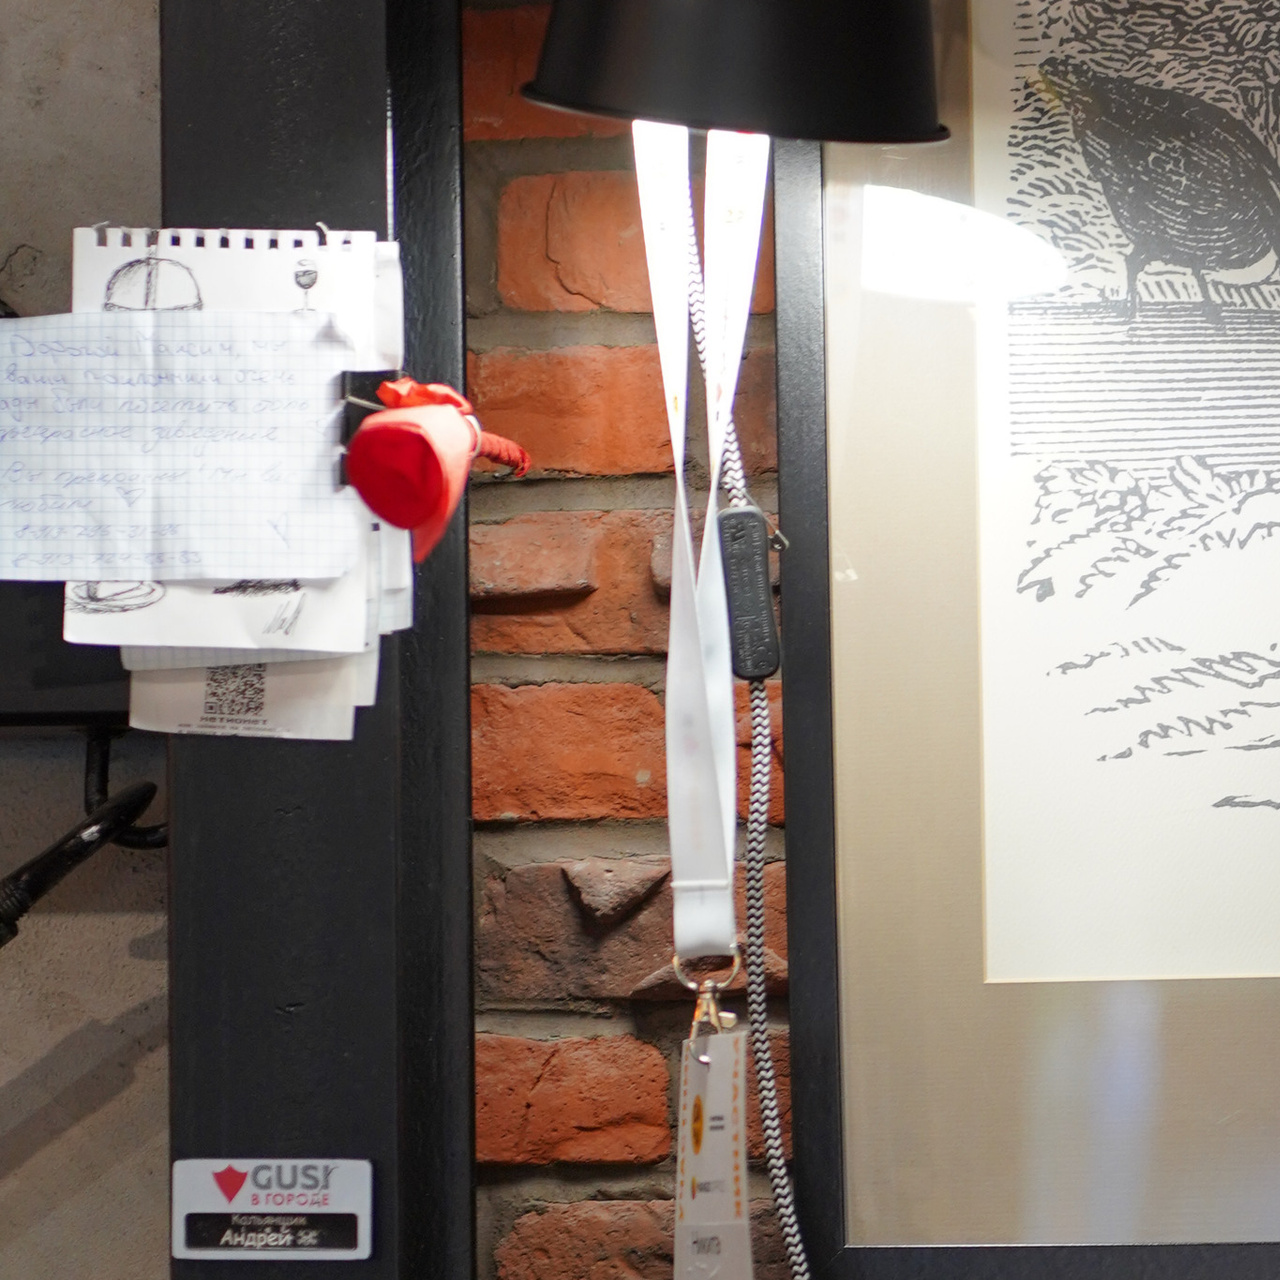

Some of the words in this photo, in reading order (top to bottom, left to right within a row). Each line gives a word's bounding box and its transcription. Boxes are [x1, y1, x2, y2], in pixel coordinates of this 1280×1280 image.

[252, 1164, 331, 1191] GUSI
[251, 1193, 260, 1206] В
[265, 1193, 330, 1207] ГОРОДЕ
[219, 1226, 292, 1249] Андрей
